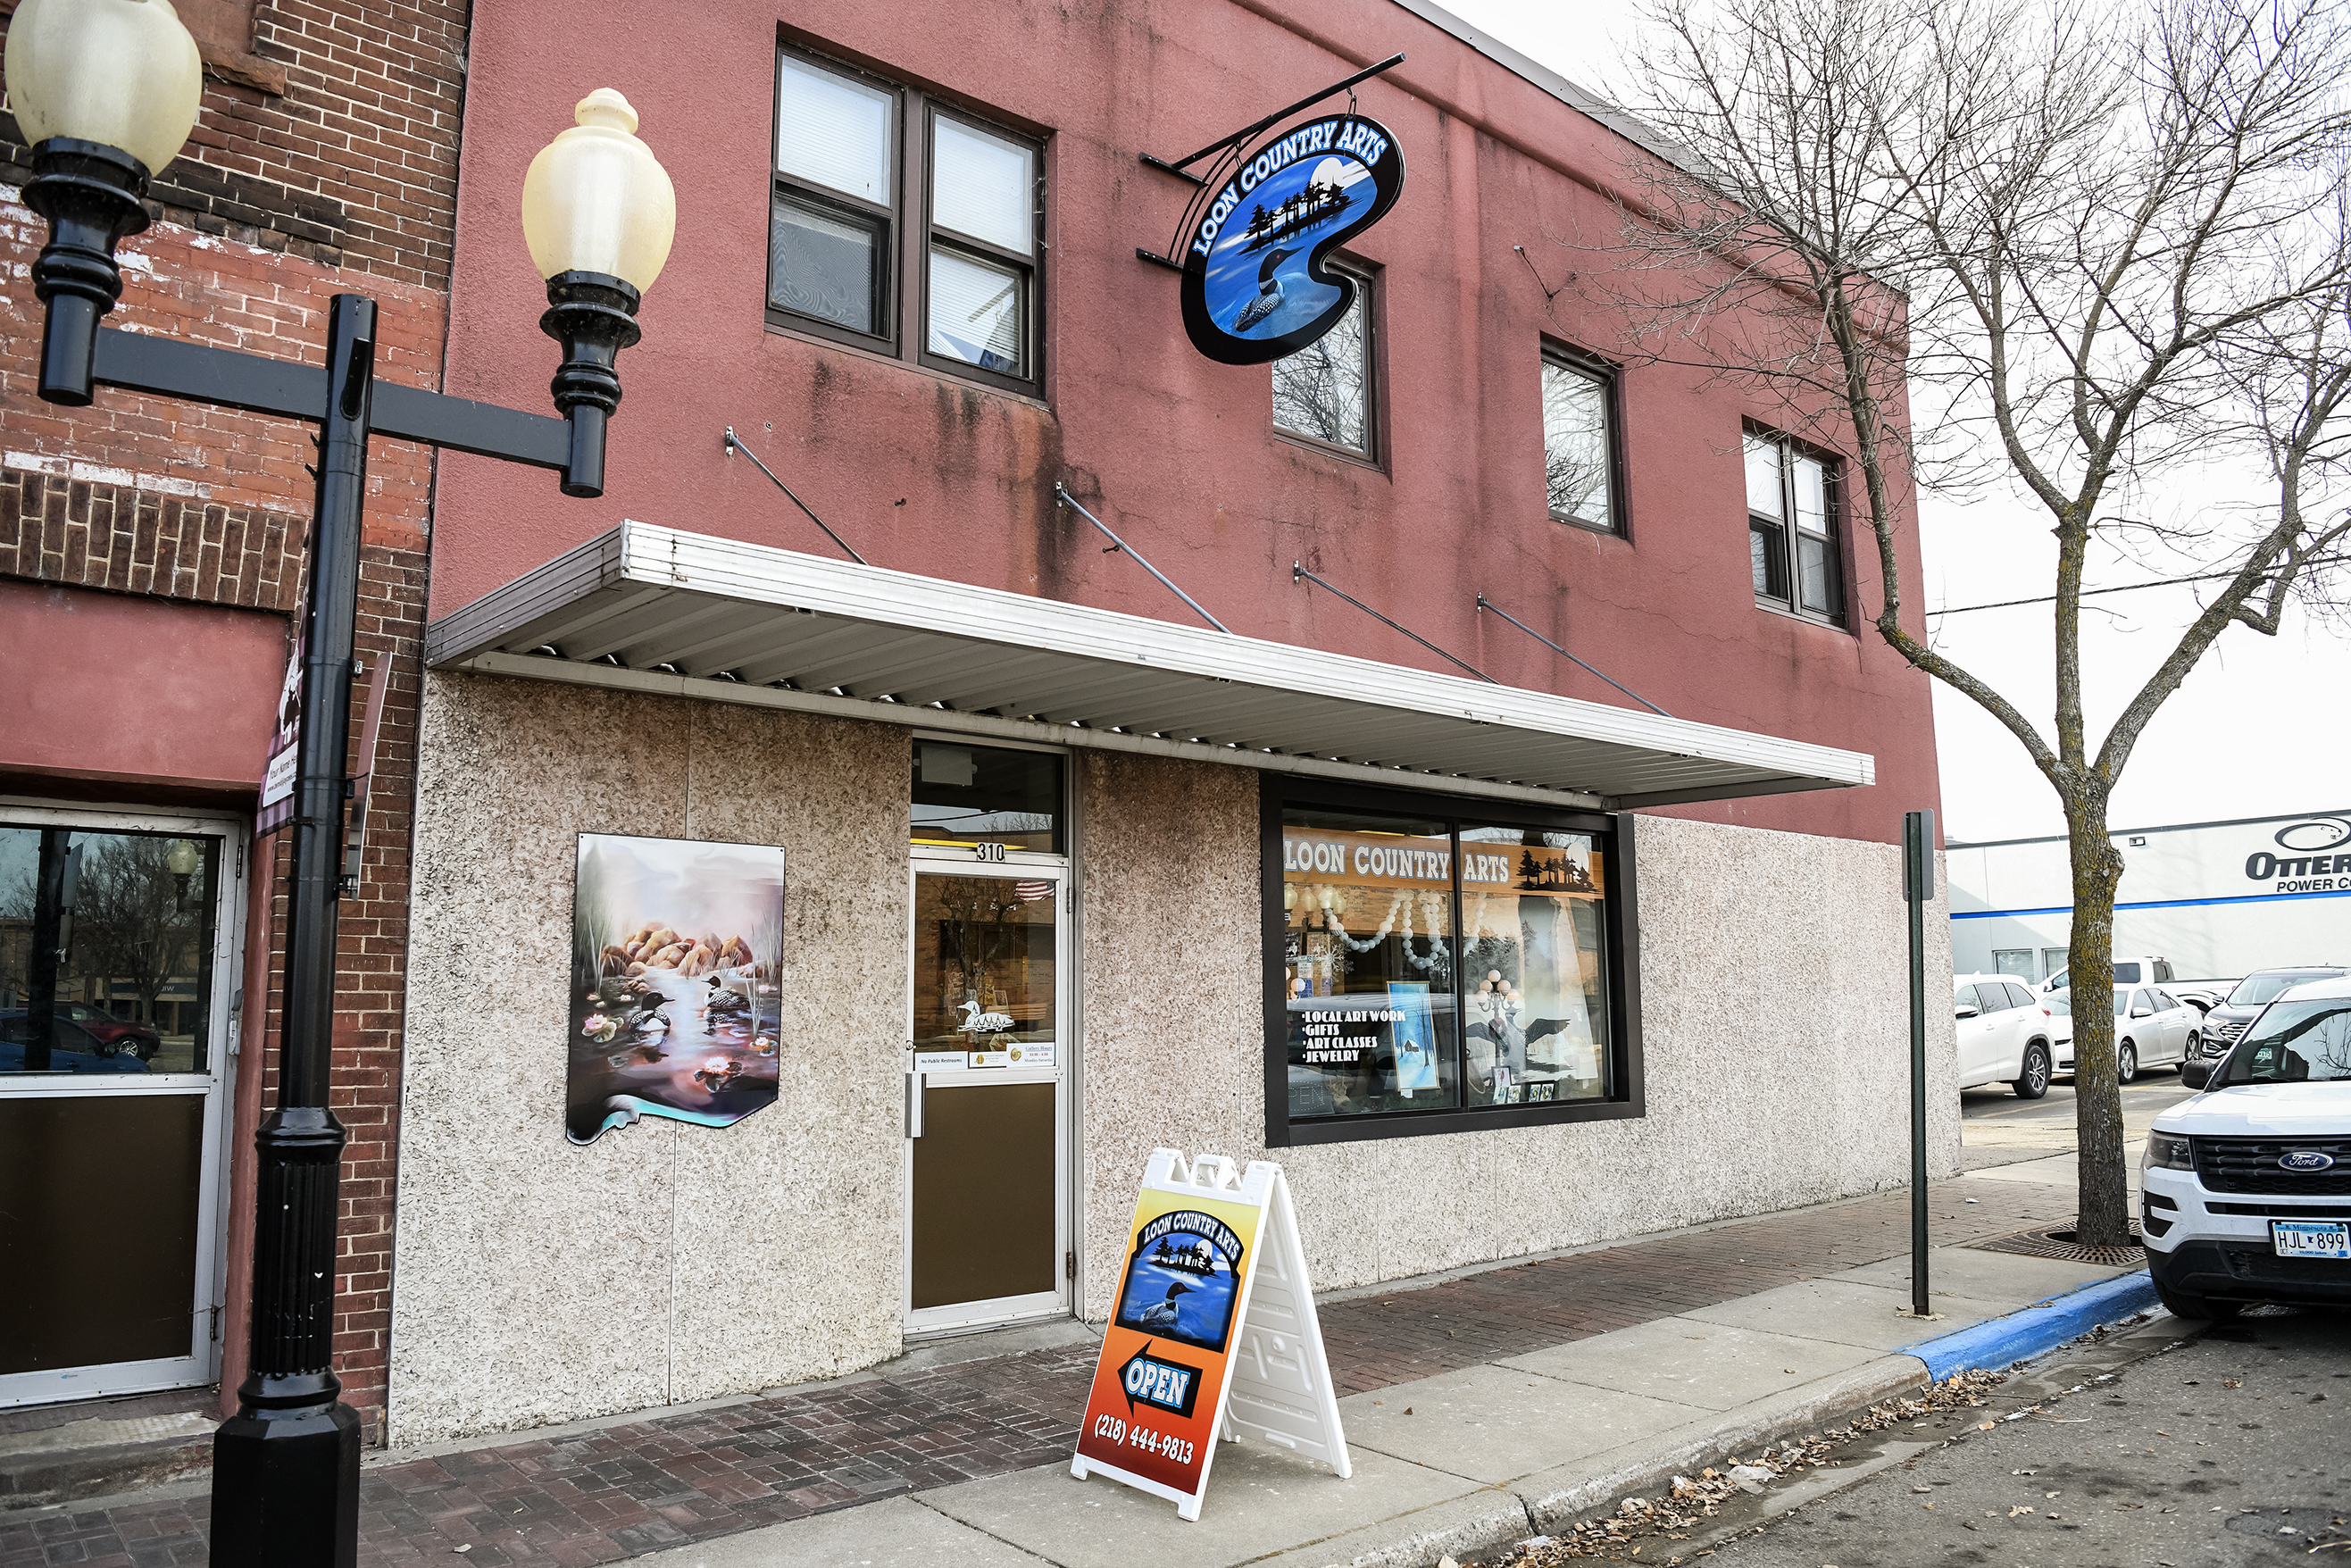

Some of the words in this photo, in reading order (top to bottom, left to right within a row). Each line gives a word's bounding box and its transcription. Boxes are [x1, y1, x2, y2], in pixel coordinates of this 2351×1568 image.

[1192, 183, 1240, 256] LOON
[1241, 121, 1338, 191] COUNTRY
[1336, 121, 1388, 167] ARTS
[978, 843, 1005, 862] 310
[1284, 838, 1346, 874] LOON
[1355, 845, 1450, 881] COUNTRY
[1463, 853, 1509, 884] ARTS
[2245, 852, 2351, 880] OTTER
[2277, 879, 2334, 892] POWER
[2338, 877, 2351, 888] C
[1305, 1011, 1343, 1022] LOCAL
[1345, 1011, 1368, 1022] ART
[1369, 1010, 1406, 1022] WORK
[1305, 1024, 1339, 1036] GIFTS
[1306, 1038, 1330, 1049] ART
[1332, 1037, 1378, 1048] CLASSES
[1305, 1050, 1360, 1063] JEWELRY
[1288, 1085, 1325, 1105] PEN
[2288, 1154, 2320, 1166] Ford
[1144, 1215, 1172, 1244] LOON
[1173, 1212, 1219, 1239] COUNTRY
[1215, 1225, 1239, 1261] ARTS
[2278, 1231, 2305, 1248] HJL
[2316, 1232, 2344, 1249] 899
[1126, 1357, 1191, 1408] OPEN
[1095, 1413, 1127, 1447] (218)
[1130, 1425, 1194, 1464] 444-9813
